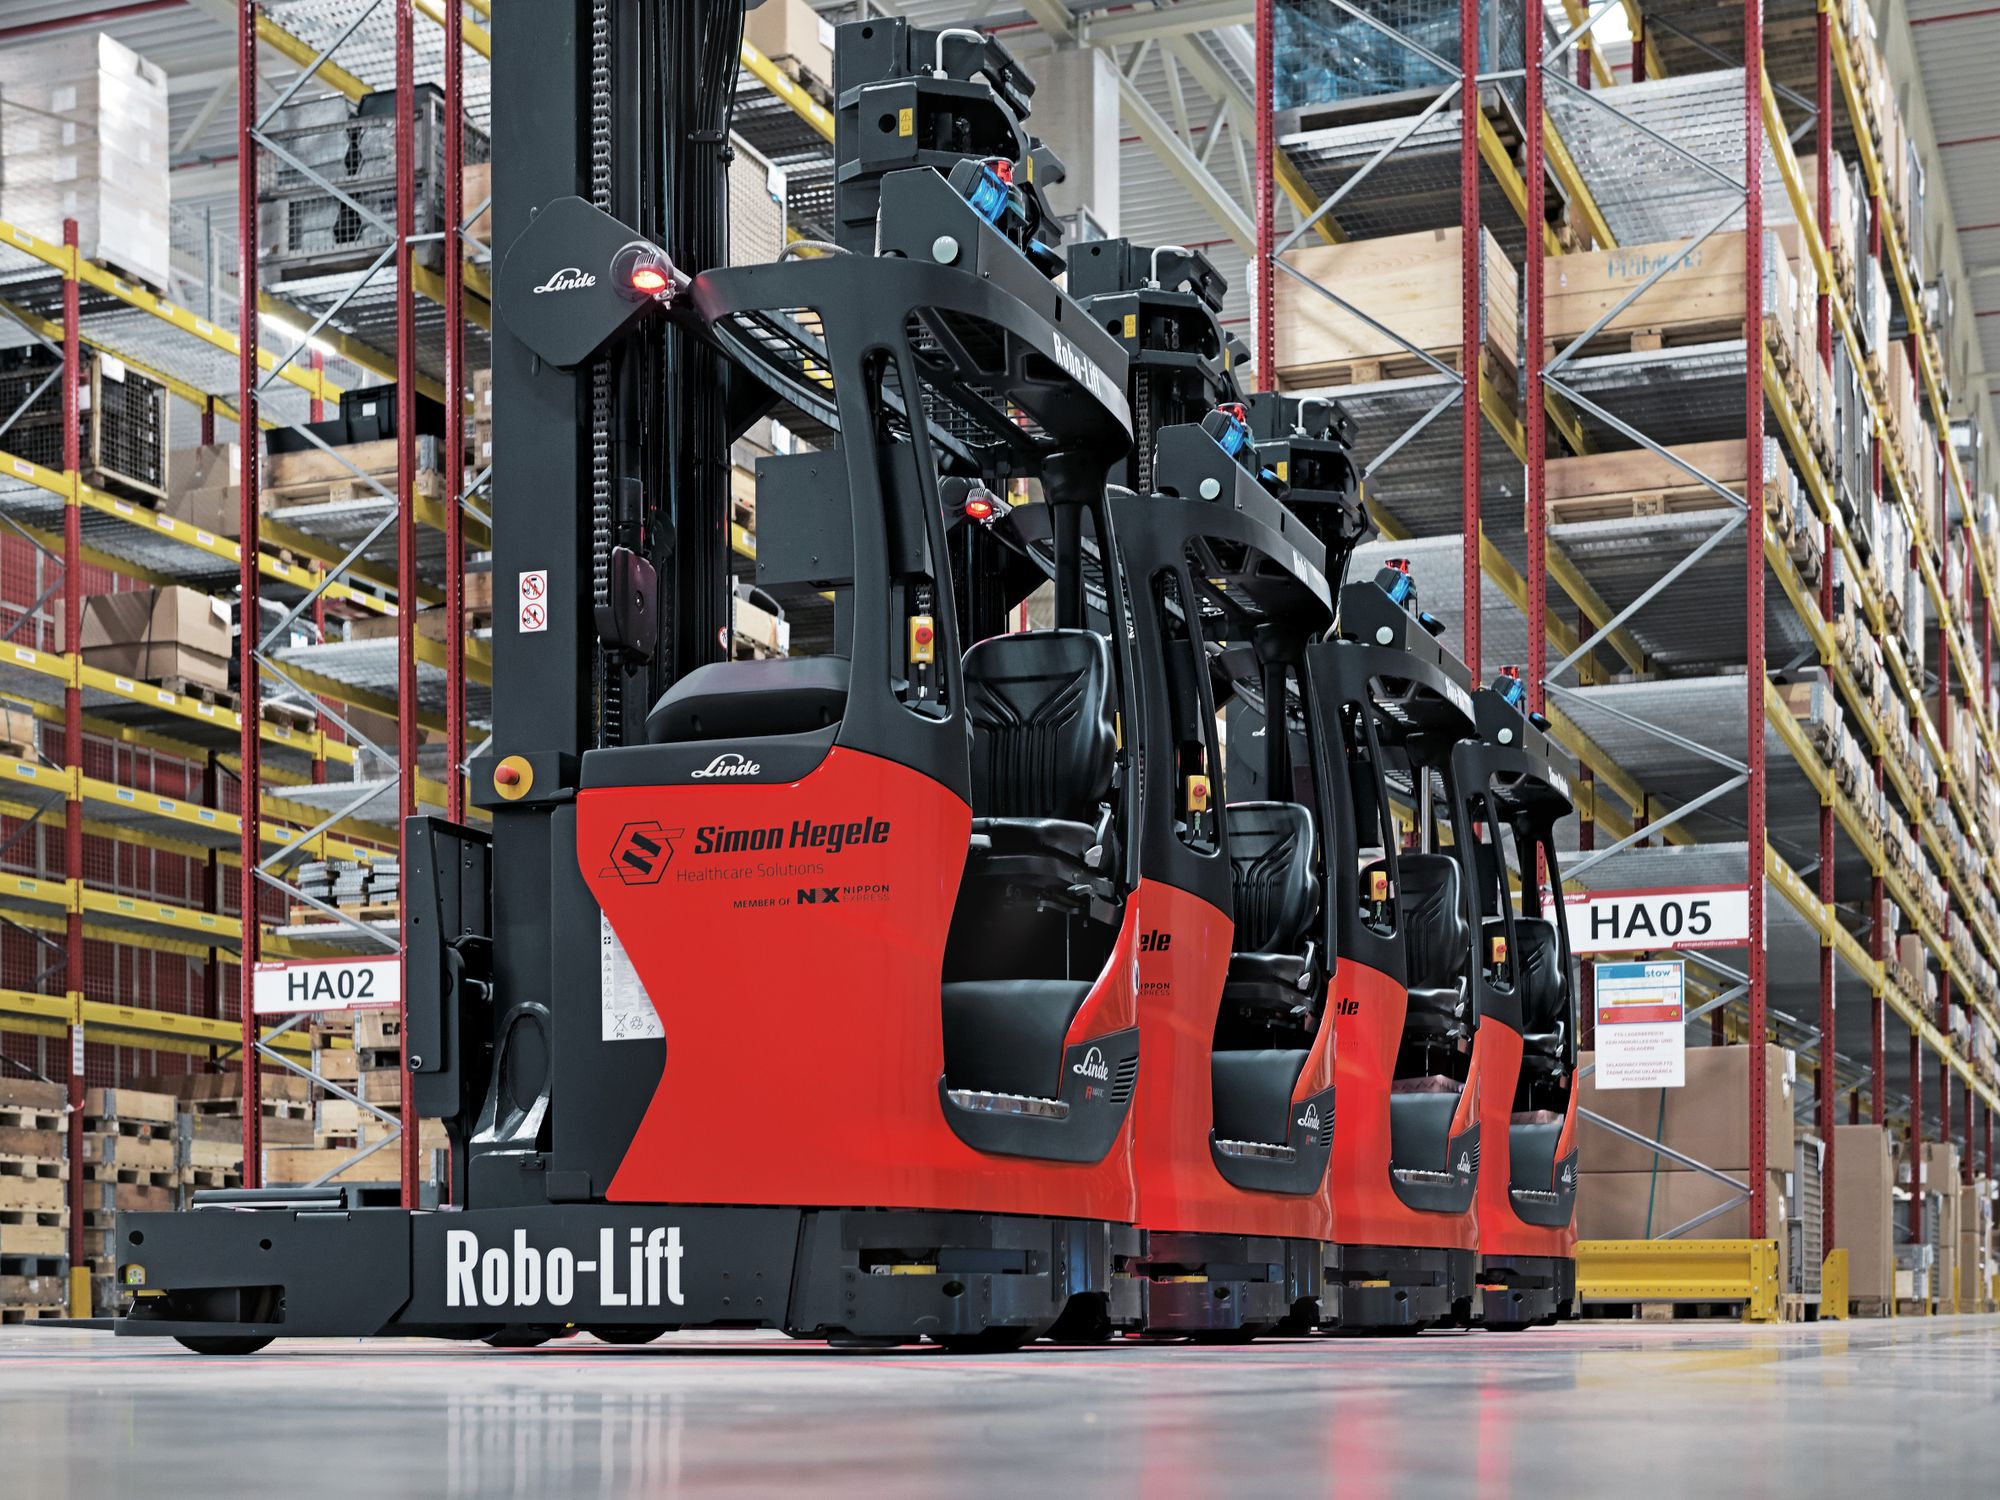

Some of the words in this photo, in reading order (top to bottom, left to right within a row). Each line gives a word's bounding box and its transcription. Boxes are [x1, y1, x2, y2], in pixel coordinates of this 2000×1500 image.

[533, 268, 596, 294] Linde
[1053, 331, 1101, 397] Robo-Lift
[691, 753, 760, 778] Linde
[694, 825, 784, 854] Simon
[789, 816, 890, 853] Hegele
[676, 865, 753, 882] Healthcare
[757, 862, 824, 878] Solutions
[733, 899, 775, 908] MEMBER
[778, 898, 791, 906] OF
[797, 886, 840, 904] NX
[843, 884, 890, 894] NIPPON
[843, 894, 890, 903] EXPRESS
[1591, 900, 1712, 940] HA05
[288, 968, 374, 1001] HA02
[1646, 968, 1670, 977] stow
[1073, 1046, 1109, 1081] Linde
[1297, 1103, 1320, 1131] Linde
[447, 1227, 684, 1306] Robo-Lift
